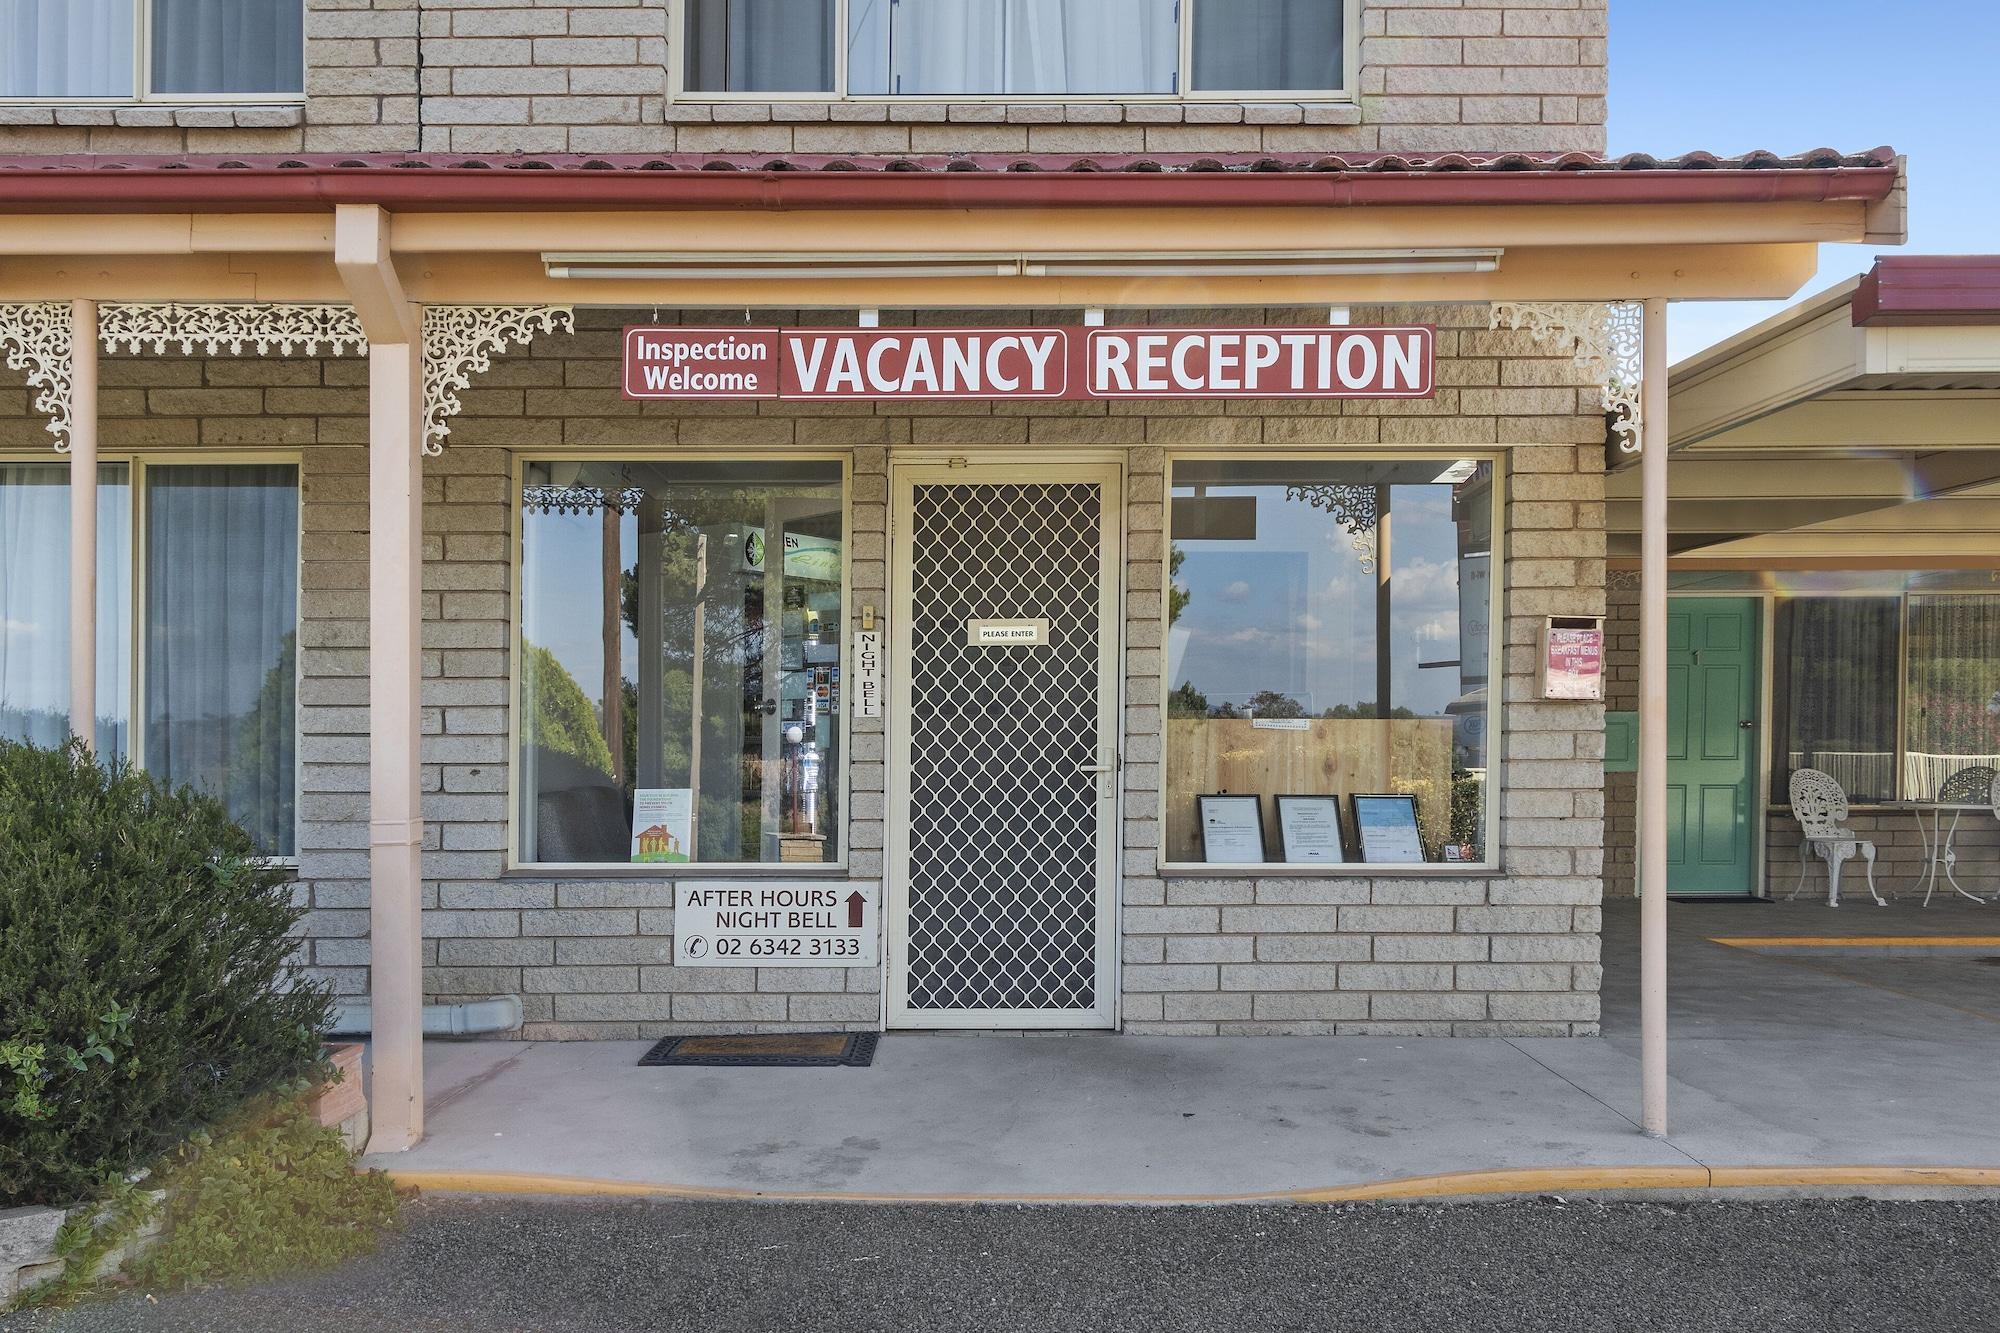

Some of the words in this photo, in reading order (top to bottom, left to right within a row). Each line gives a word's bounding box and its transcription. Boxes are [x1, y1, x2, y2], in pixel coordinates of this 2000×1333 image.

[636, 335, 767, 367] Inspection
[789, 336, 1057, 393] VACANCY
[1095, 334, 1421, 391] RECEPTION
[643, 366, 758, 391] Welcome
[983, 630, 1009, 638] PLEASE
[1011, 630, 1034, 638] ENTER
[861, 634, 875, 677] NIGHT
[863, 682, 875, 715] BELL
[687, 890, 754, 907] AFTER
[761, 890, 837, 907] HOURS
[716, 911, 782, 928] NIGHT
[788, 911, 837, 928] BELL
[716, 938, 742, 955] 02
[750, 938, 801, 955] 6342
[809, 938, 860, 955] 3133
